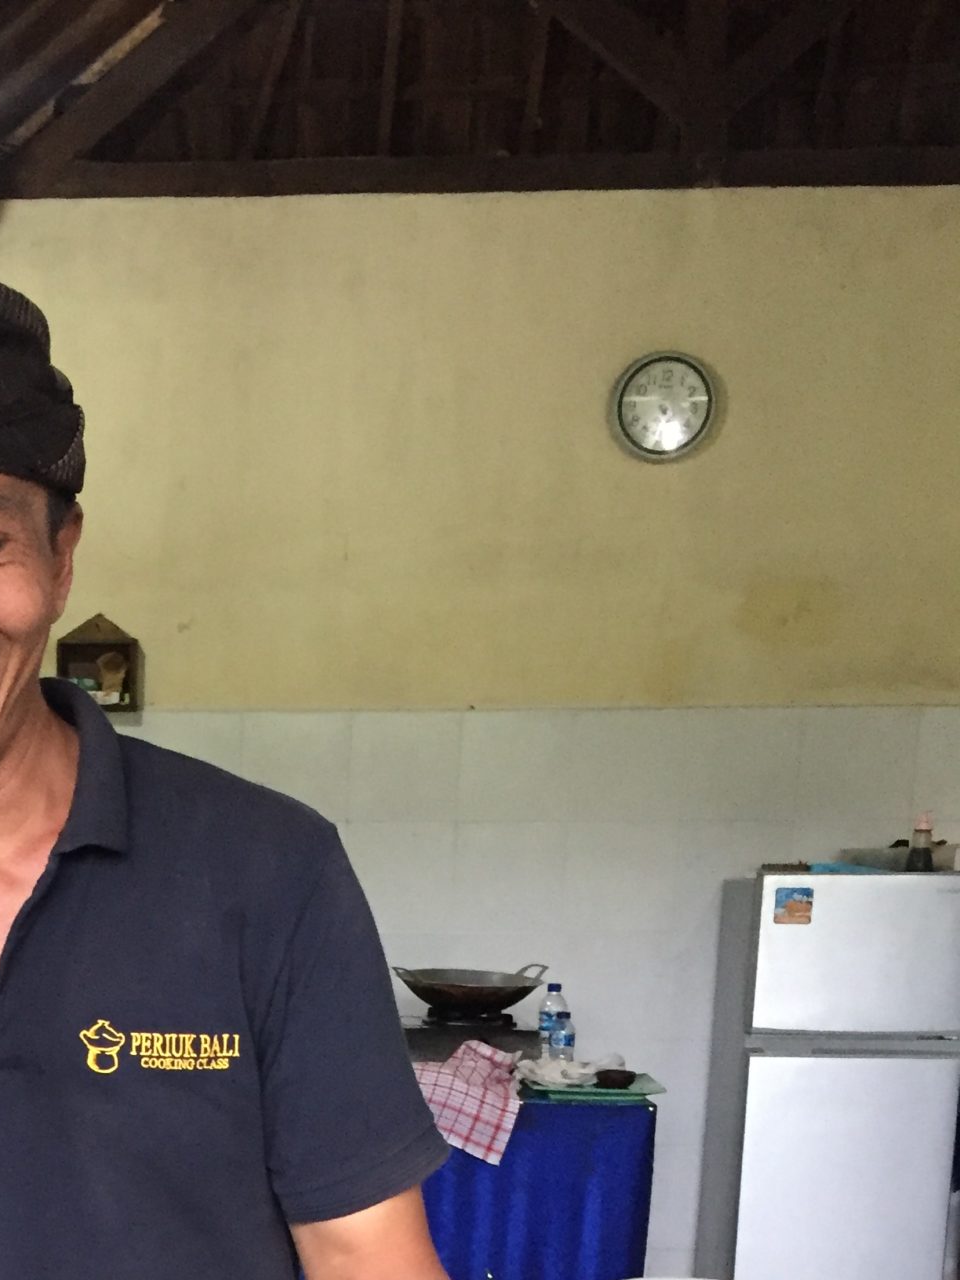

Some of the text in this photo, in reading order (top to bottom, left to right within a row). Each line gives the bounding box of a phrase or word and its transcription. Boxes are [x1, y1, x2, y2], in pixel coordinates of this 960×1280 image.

[129, 1032, 240, 1058] PERIUK BALI
[140, 1057, 229, 1070] COOKING CLASS
